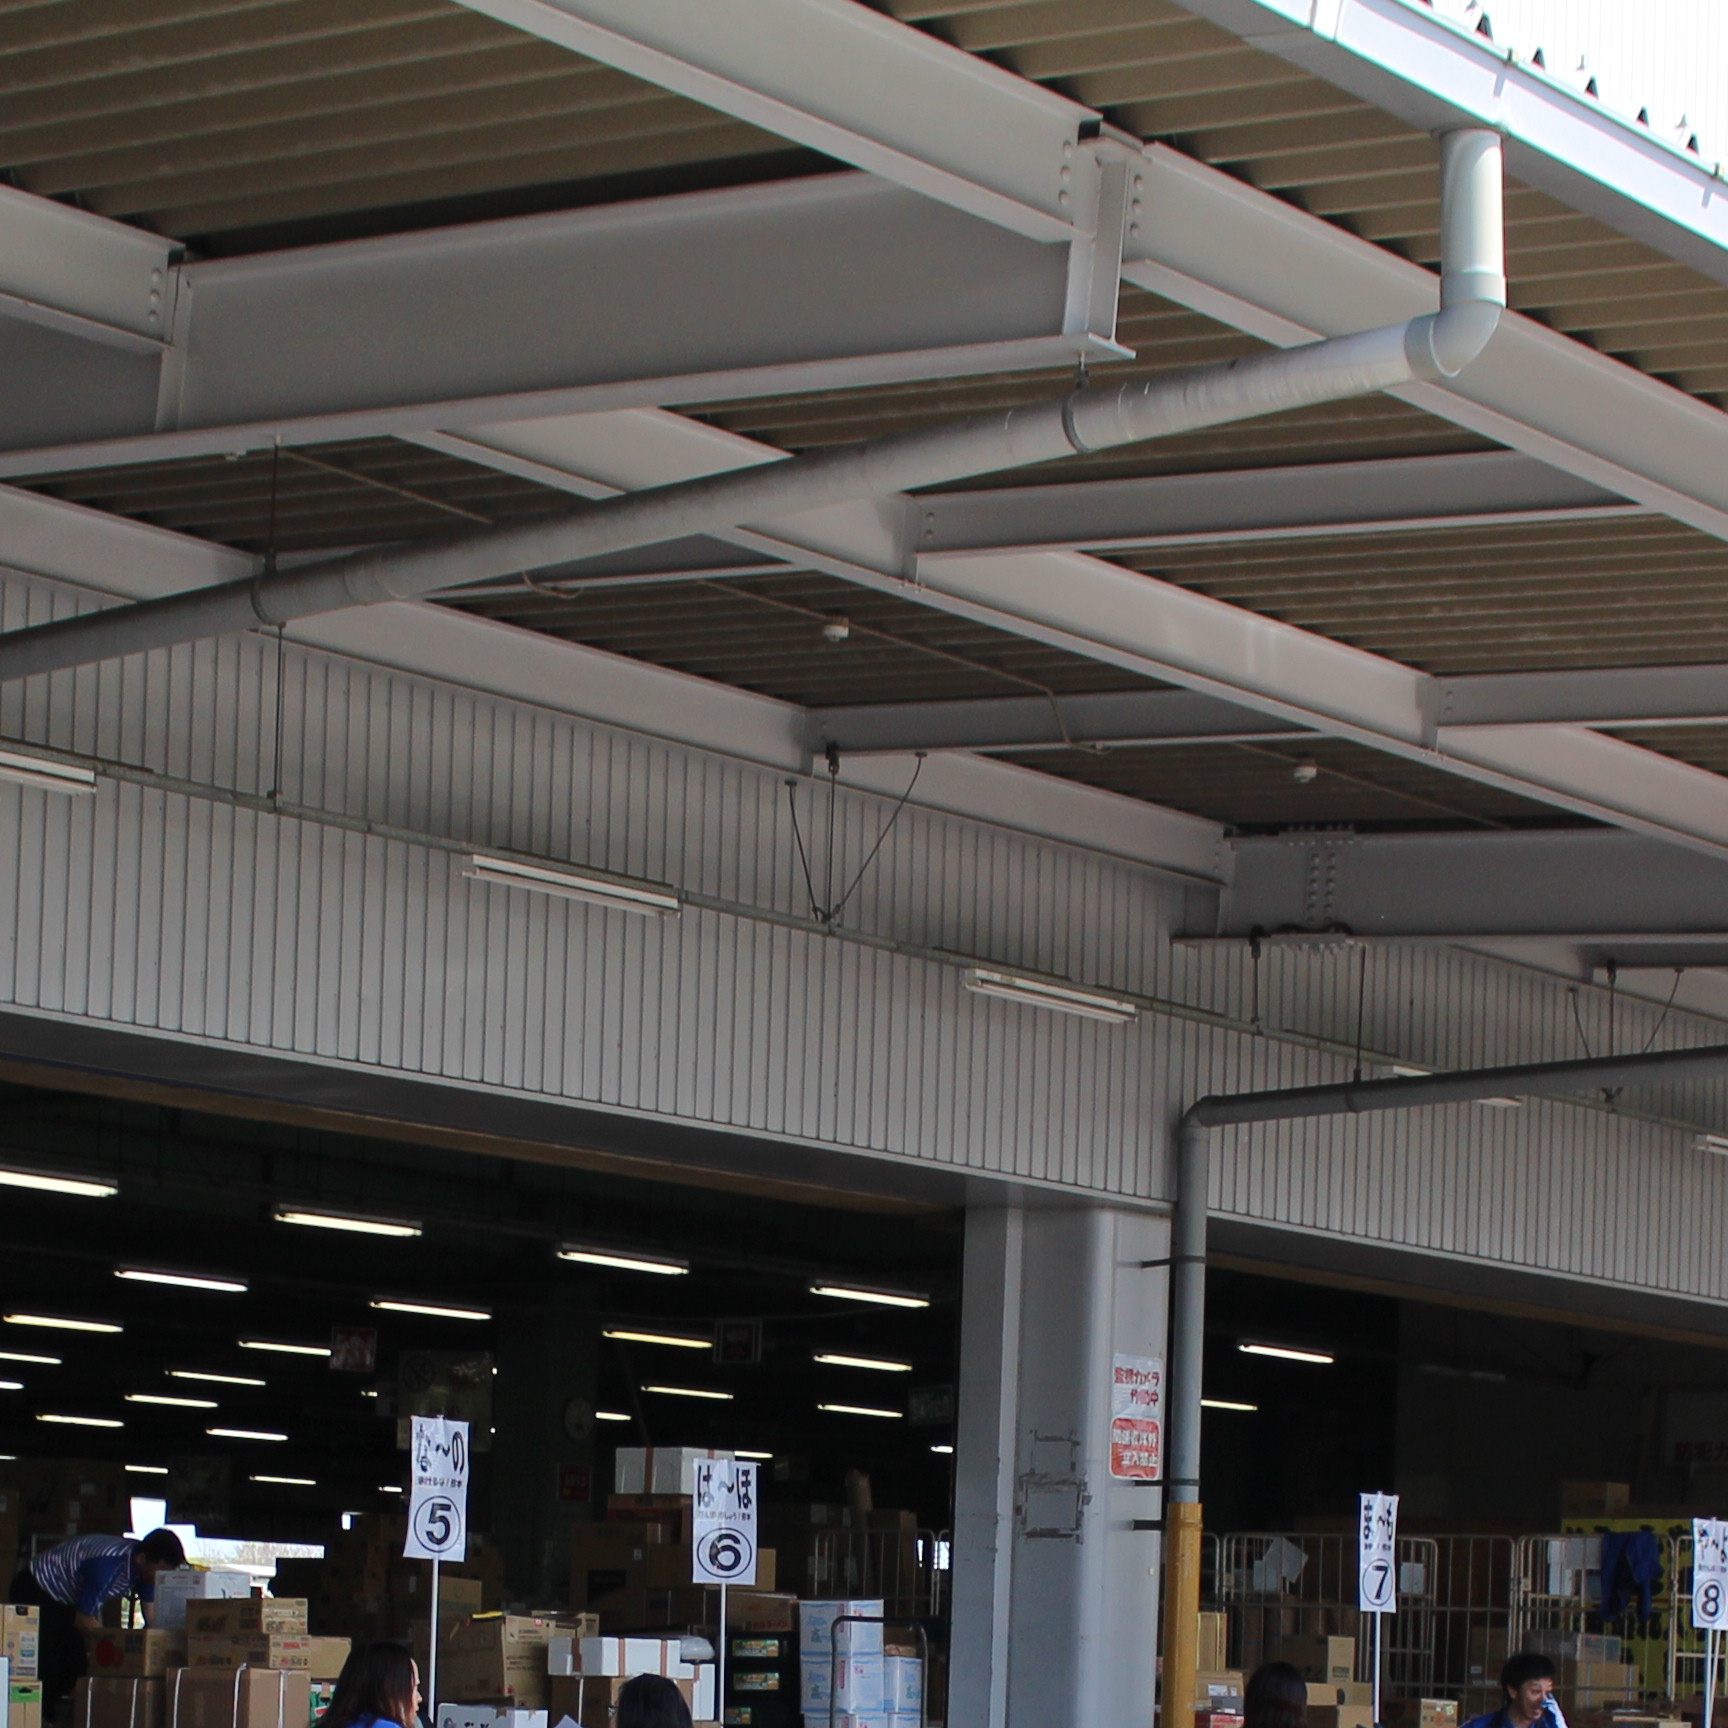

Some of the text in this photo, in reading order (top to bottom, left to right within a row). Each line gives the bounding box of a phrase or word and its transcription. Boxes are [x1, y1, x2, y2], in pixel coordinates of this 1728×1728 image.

[426, 1503, 452, 1546] 5
[709, 1533, 741, 1572] 6
[1372, 1565, 1389, 1600] 7
[1702, 1584, 1720, 1617] 8
